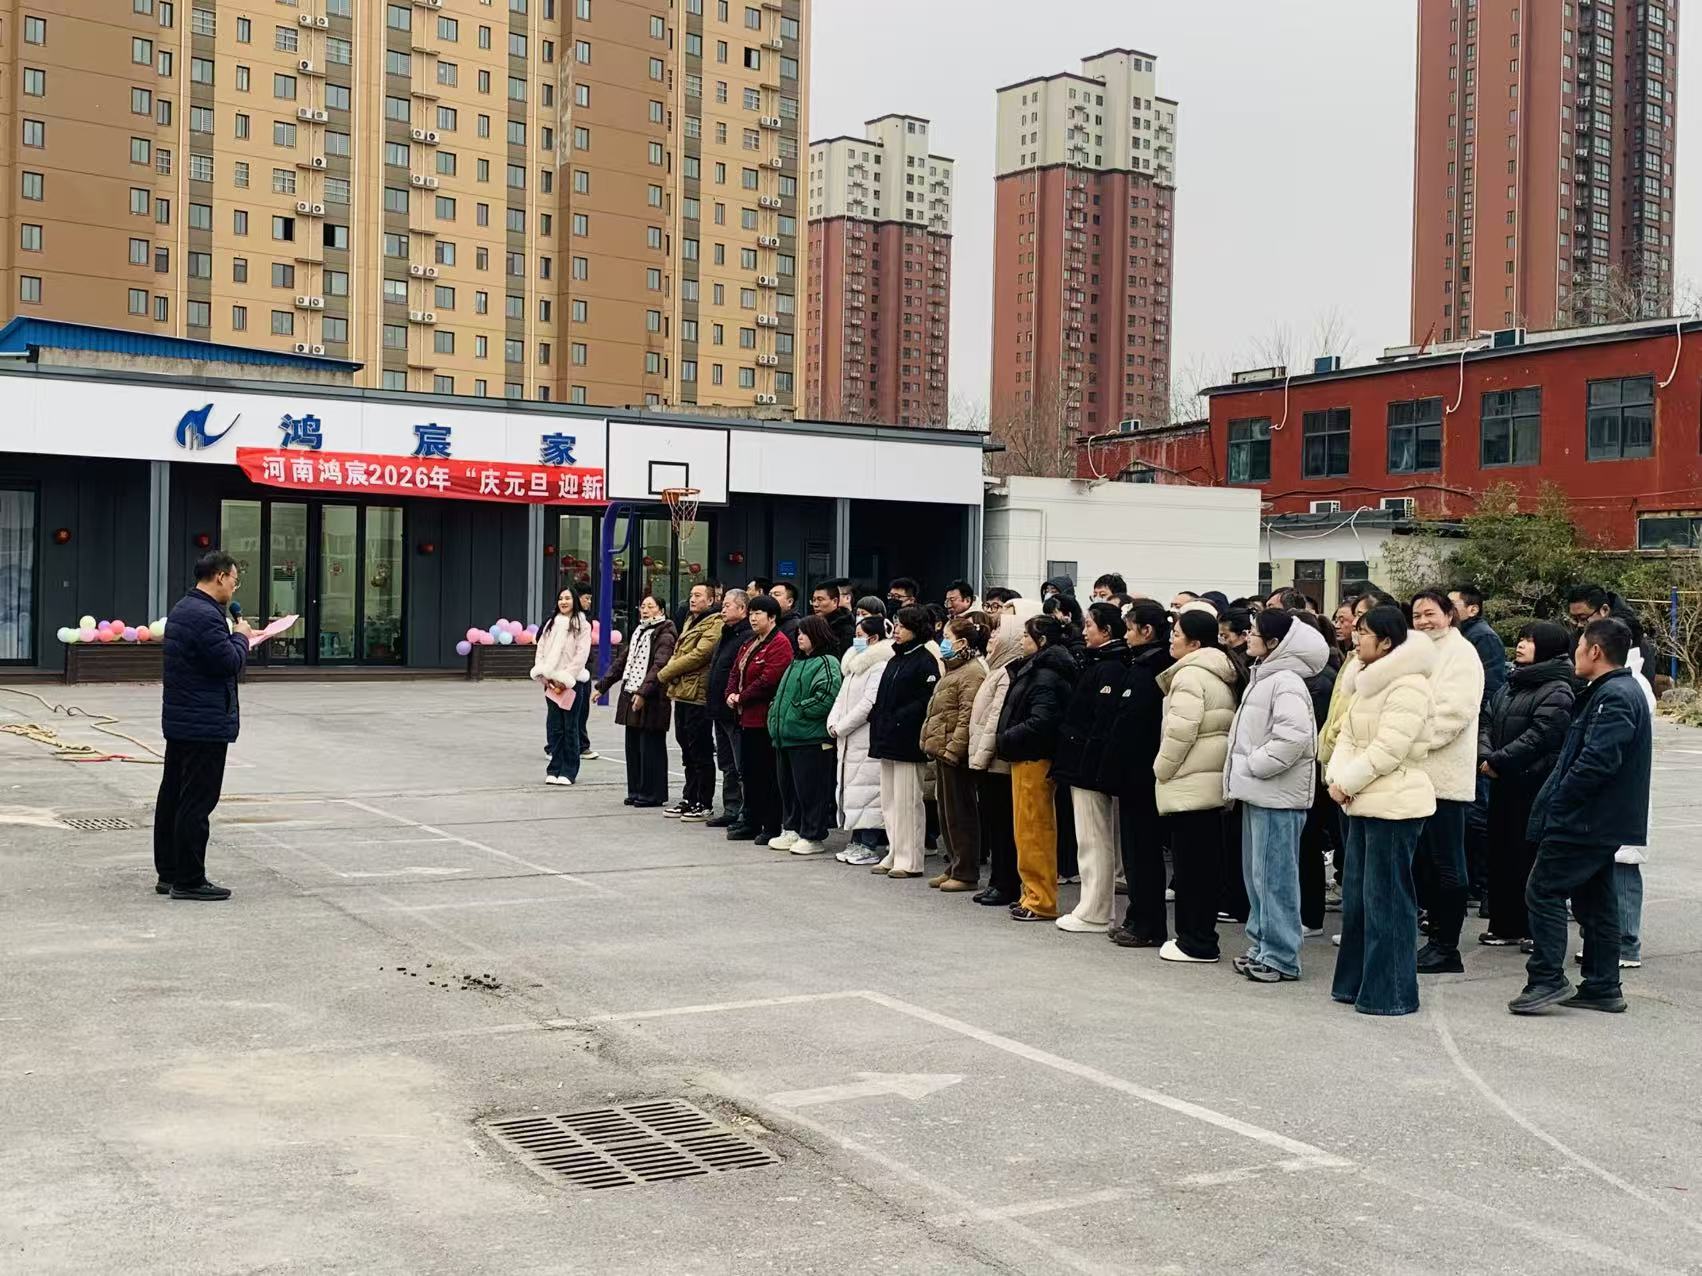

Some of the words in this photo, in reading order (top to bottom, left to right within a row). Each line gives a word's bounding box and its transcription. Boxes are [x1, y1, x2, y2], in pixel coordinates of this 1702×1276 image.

[262, 456, 451, 492] 河南鸿宸2026年
